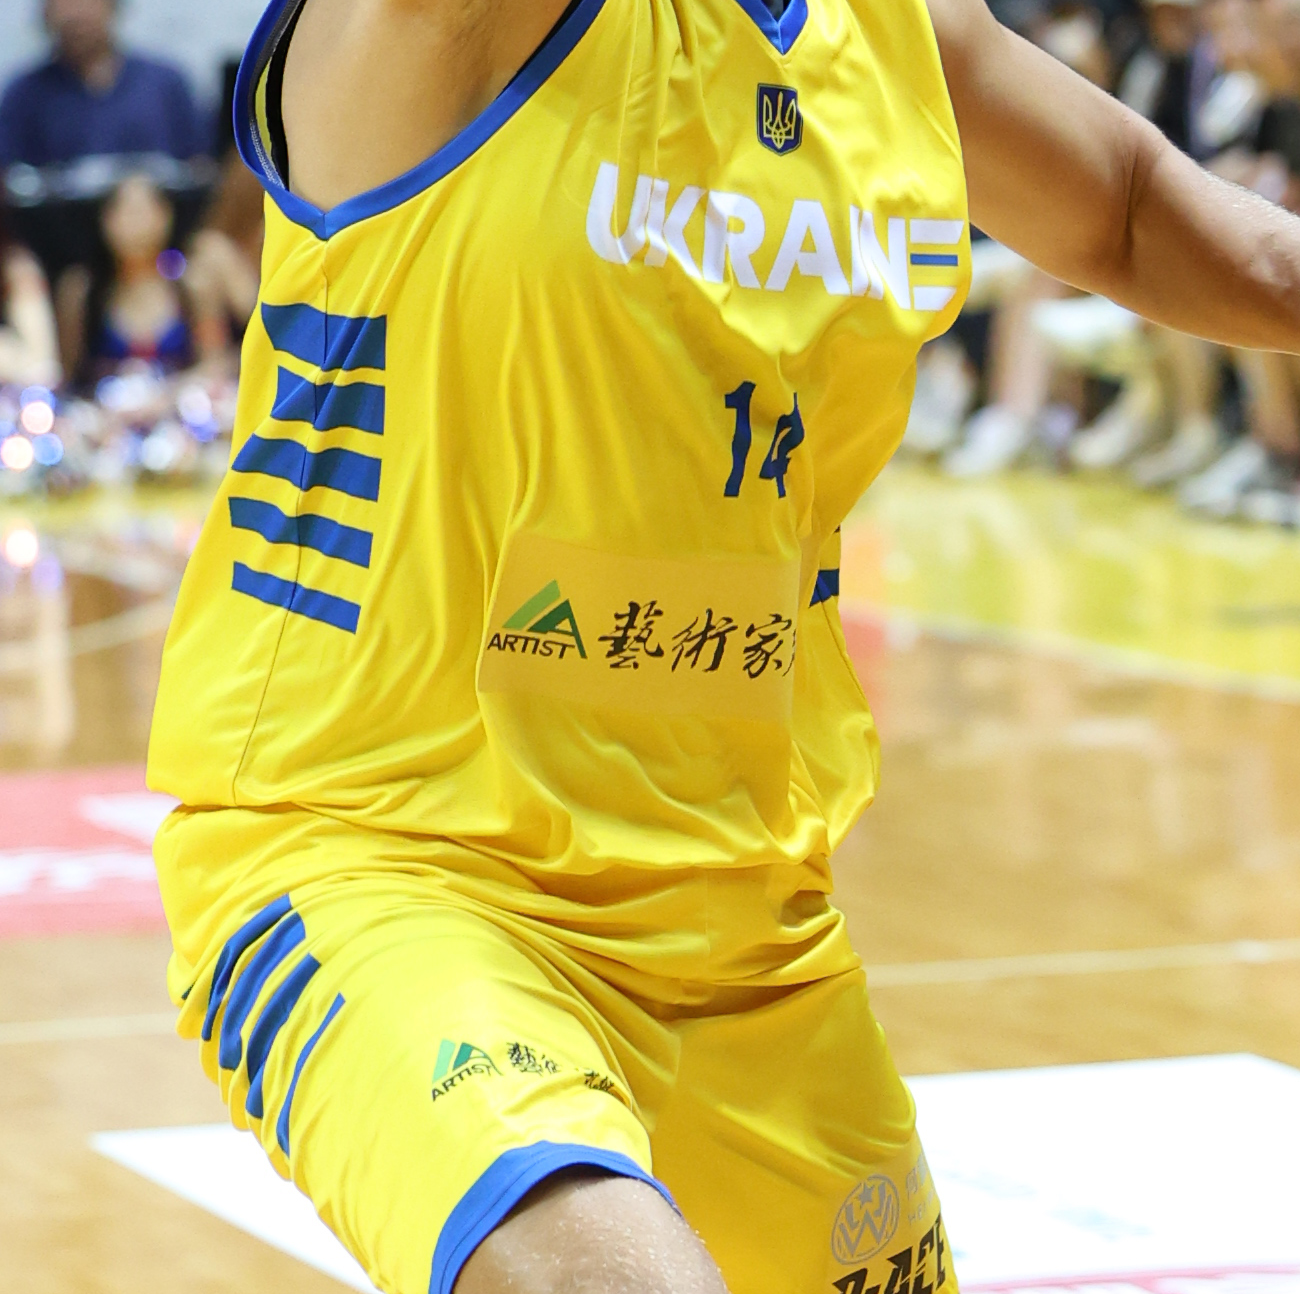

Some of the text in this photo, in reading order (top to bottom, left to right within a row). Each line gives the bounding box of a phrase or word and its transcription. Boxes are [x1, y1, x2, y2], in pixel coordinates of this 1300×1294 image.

[723, 381, 805, 499] 14
[487, 632, 576, 659] ARTIST
[597, 601, 797, 679] 藝術家
[431, 1063, 492, 1103] ARTIST
